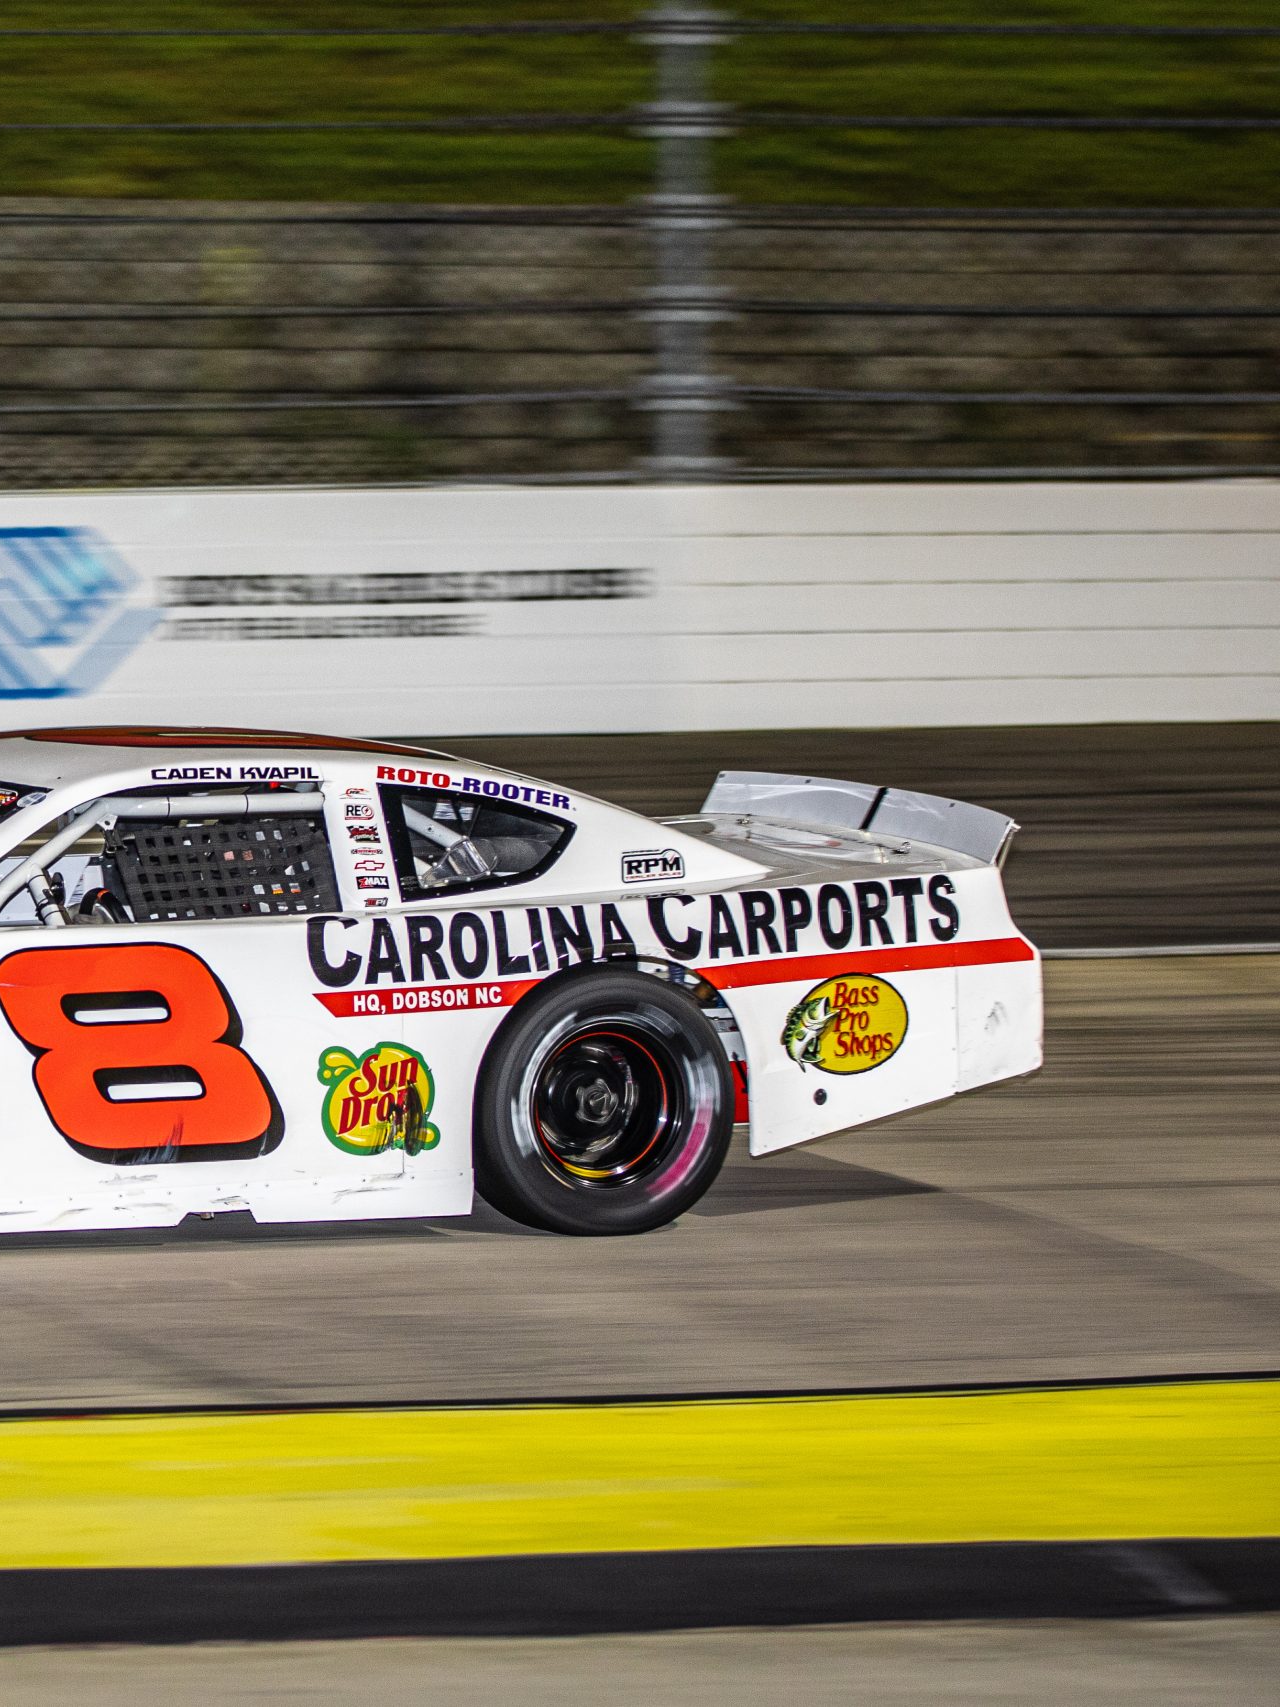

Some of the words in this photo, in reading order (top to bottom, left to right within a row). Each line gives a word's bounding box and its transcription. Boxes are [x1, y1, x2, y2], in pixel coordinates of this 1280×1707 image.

[151, 767, 232, 780] CADEN
[240, 767, 319, 780] KVAPIL
[376, 766, 571, 810] ROTO-ROOTER
[624, 857, 681, 875] RPM
[306, 903, 638, 988] CAROLINA
[647, 874, 960, 961] CARPORTS
[353, 994, 387, 1014] HQ,
[392, 988, 469, 1010] DOBSON
[475, 986, 503, 1005] NC
[832, 981, 880, 1008] Bass
[833, 1007, 870, 1032] Pro
[834, 1030, 894, 1060] Shops
[349, 1054, 419, 1098] Sun
